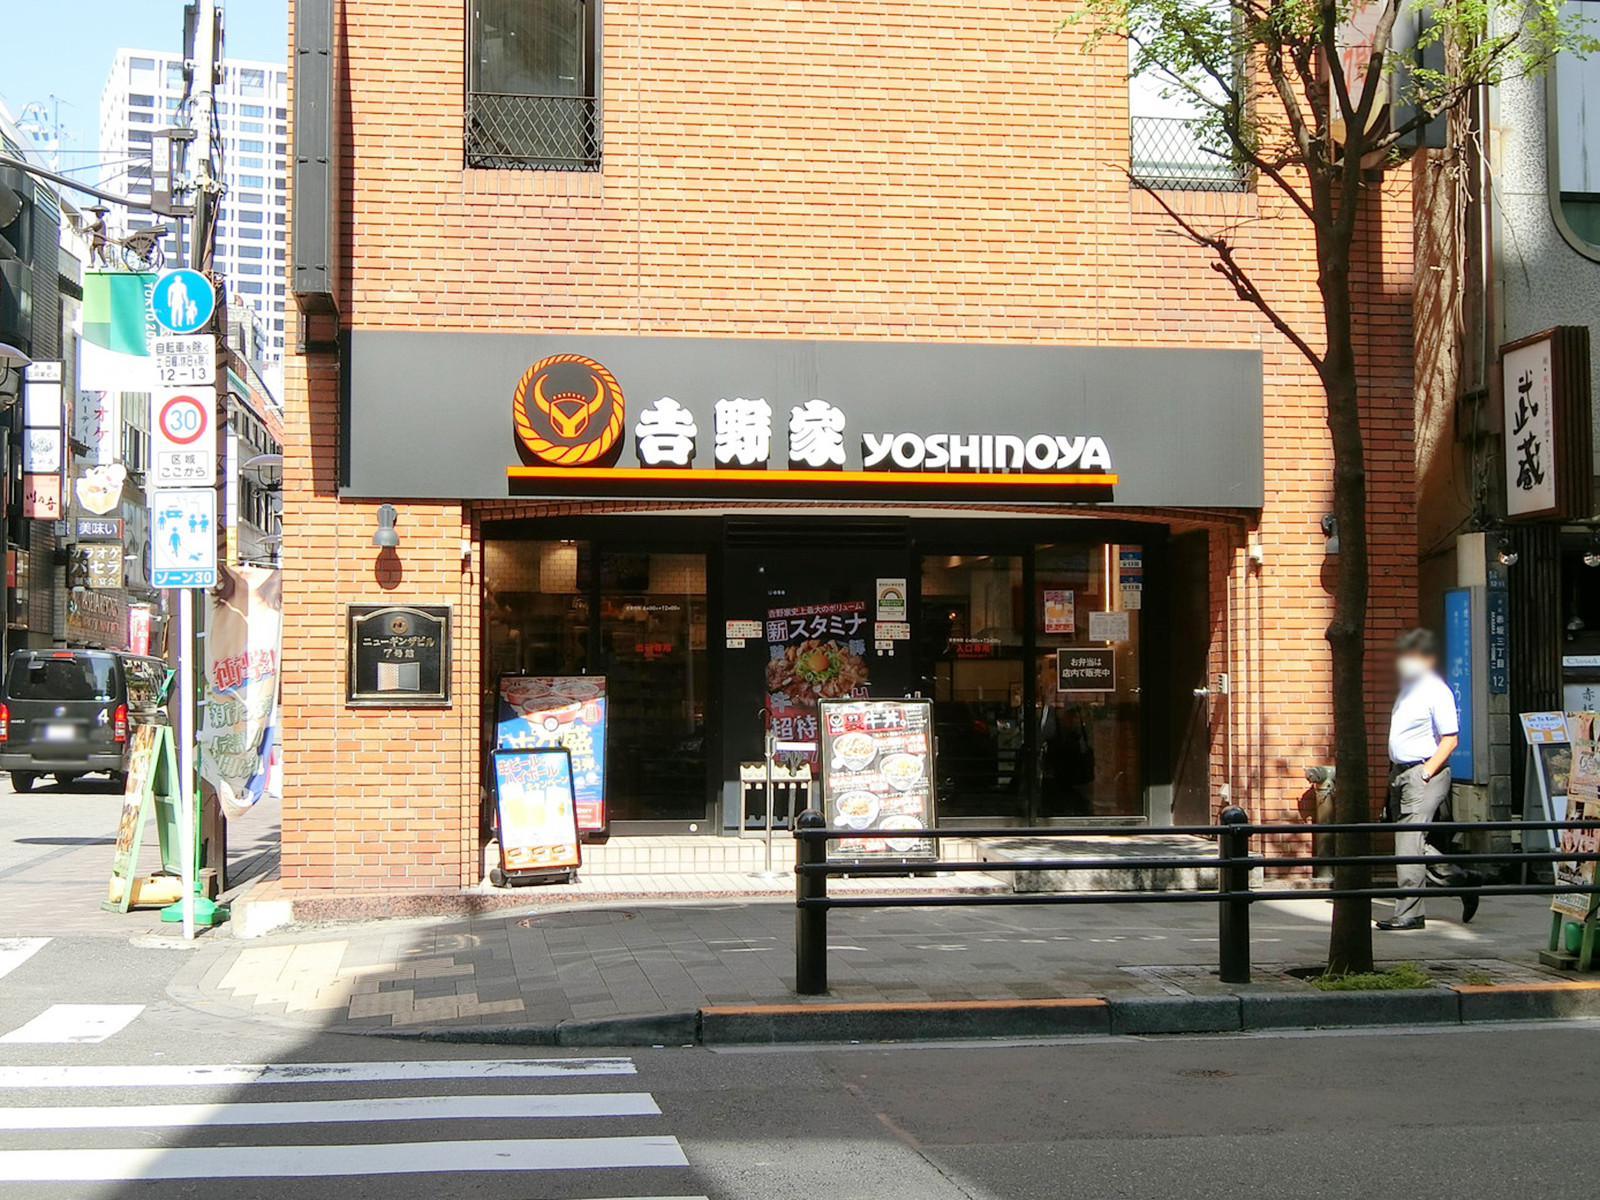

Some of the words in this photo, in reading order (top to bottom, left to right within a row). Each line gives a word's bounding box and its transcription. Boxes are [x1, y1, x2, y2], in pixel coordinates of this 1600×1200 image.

[156, 341, 210, 353] 自転車を除く
[160, 367, 207, 381] 12-13
[170, 409, 197, 431] 30
[635, 396, 846, 468] 吉野家
[863, 432, 1112, 470] YOSHINOYA
[171, 454, 196, 465] 区域
[161, 466, 206, 478] ここから
[80, 521, 118, 535] 美味い
[71, 547, 119, 560] カラオケ
[71, 559, 120, 575] パセラ
[362, 636, 436, 648] ニューギンザビル
[1070, 657, 1102, 667] お弁当は
[1062, 668, 1111, 678] 店内で販売中
[1492, 676, 1505, 687] 12
